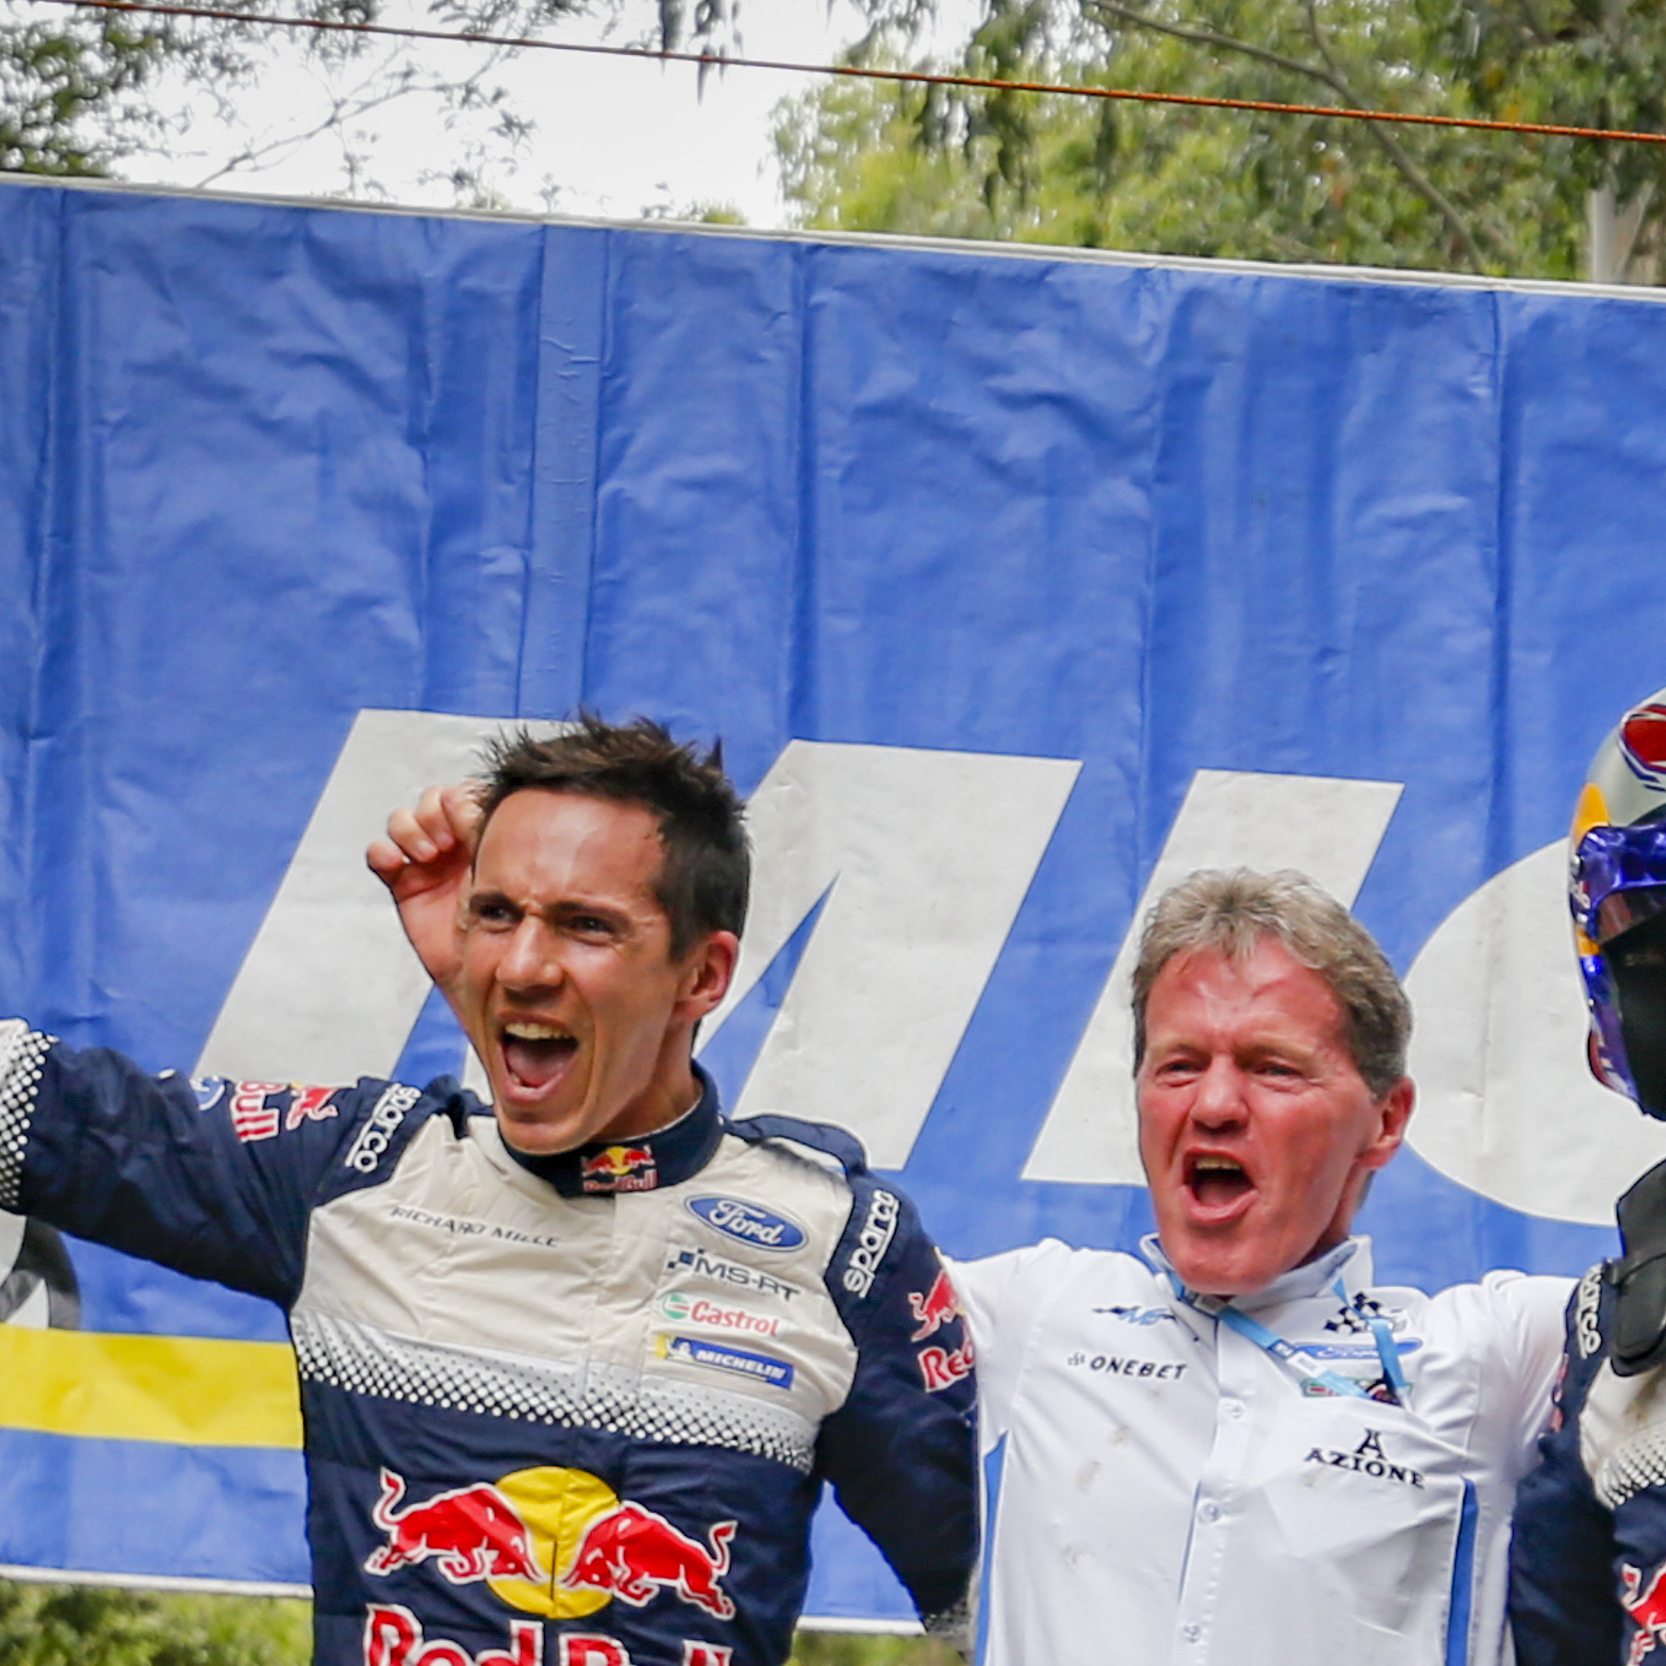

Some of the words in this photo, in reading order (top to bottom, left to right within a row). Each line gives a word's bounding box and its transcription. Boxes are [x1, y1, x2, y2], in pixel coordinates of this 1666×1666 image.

[346, 1083, 423, 1174] sparco
[390, 1205, 487, 1235] RICHARD
[708, 1199, 786, 1246] Ford
[690, 1300, 781, 1338] Castrol
[695, 1348, 787, 1381] MICHELIN
[1089, 1355, 1188, 1381] ONEBET
[1303, 1446, 1426, 1491] AZIONE
